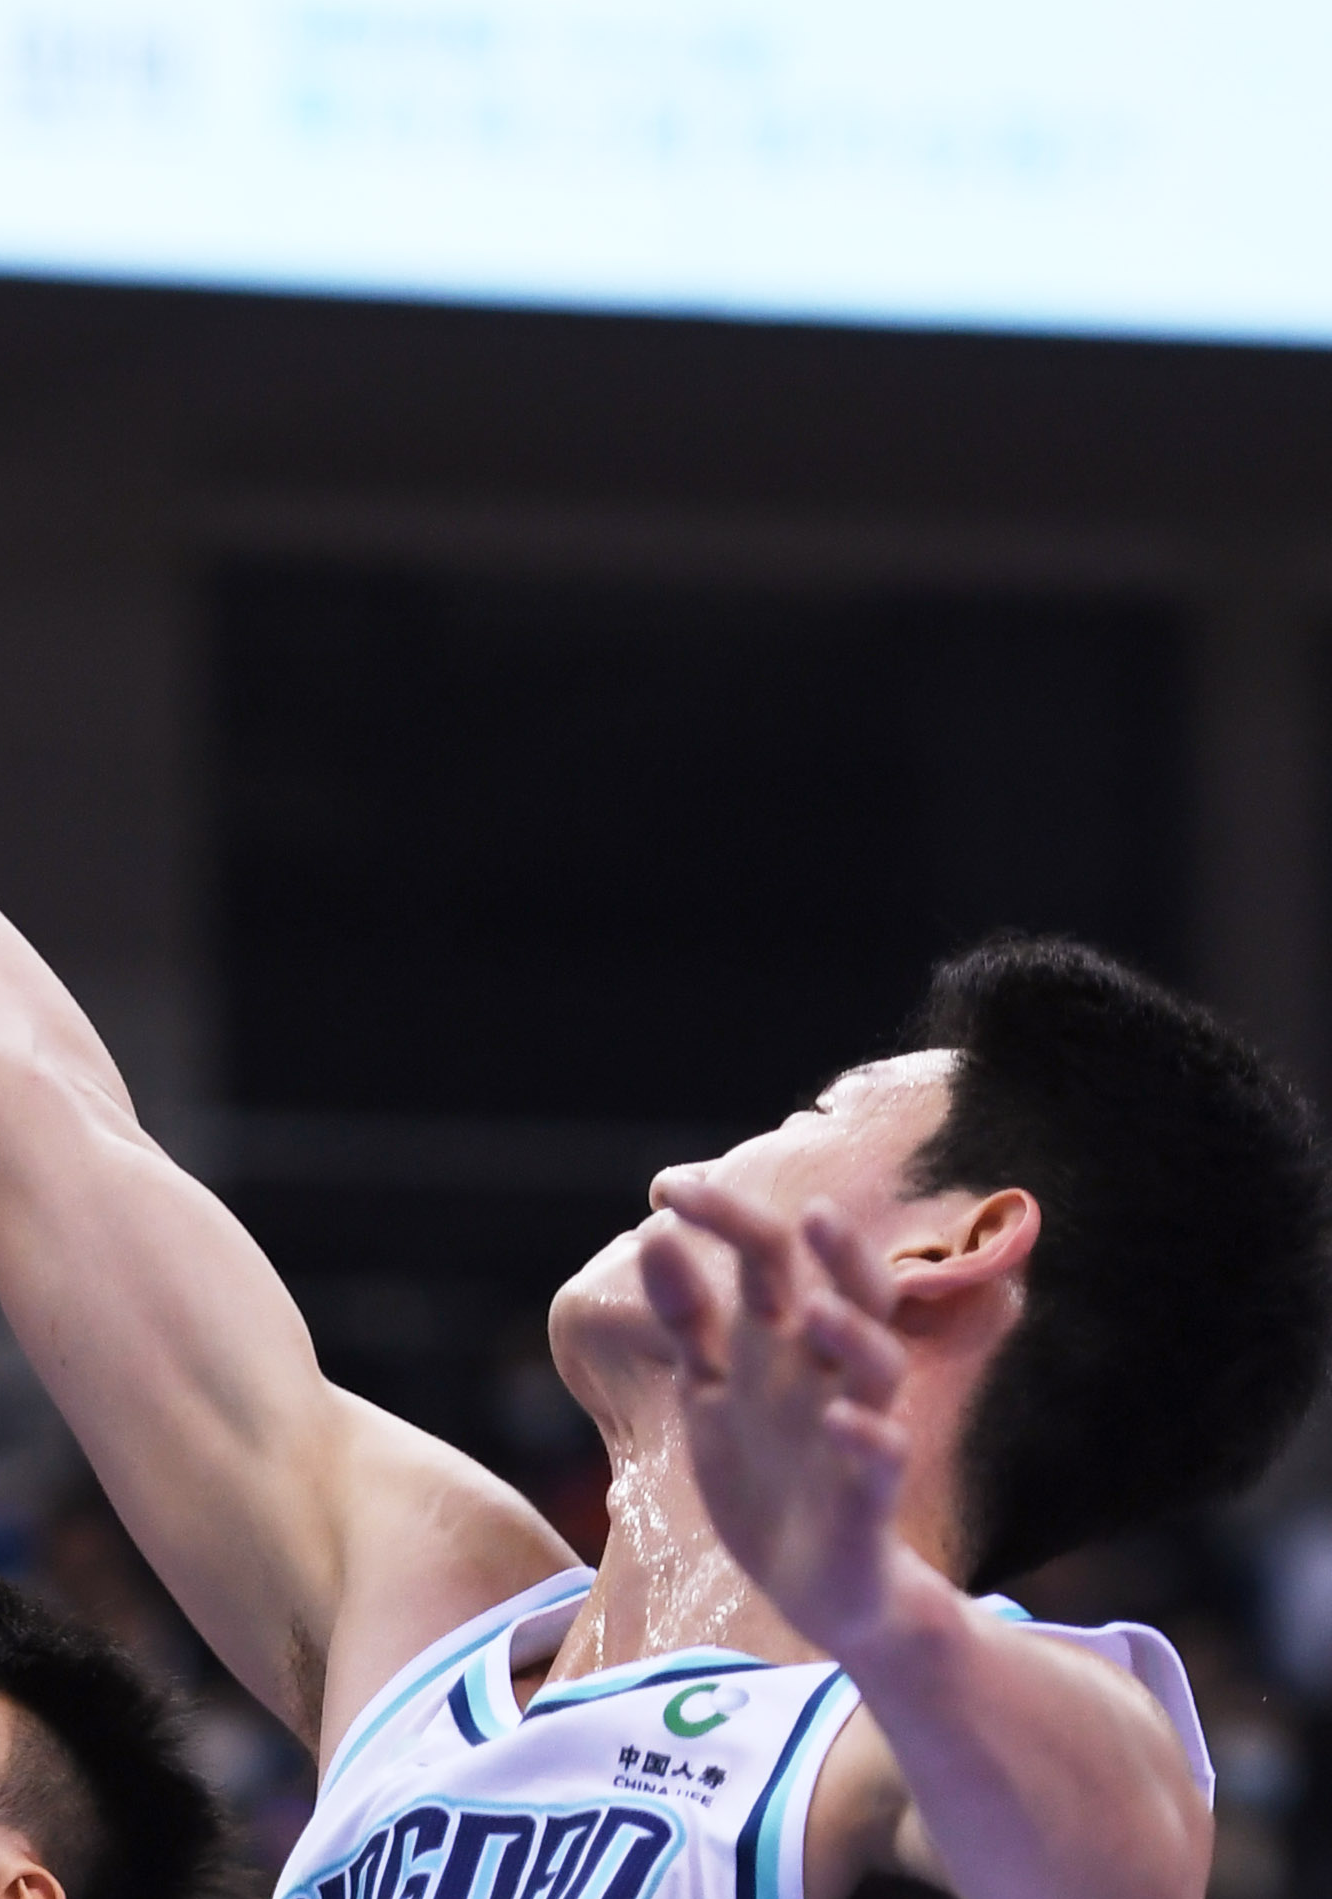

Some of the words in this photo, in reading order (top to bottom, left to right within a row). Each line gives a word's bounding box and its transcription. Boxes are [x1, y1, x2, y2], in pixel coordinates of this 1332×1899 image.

[618, 1743, 727, 1790] 中国人寿
[613, 1774, 668, 1796] CHINA
